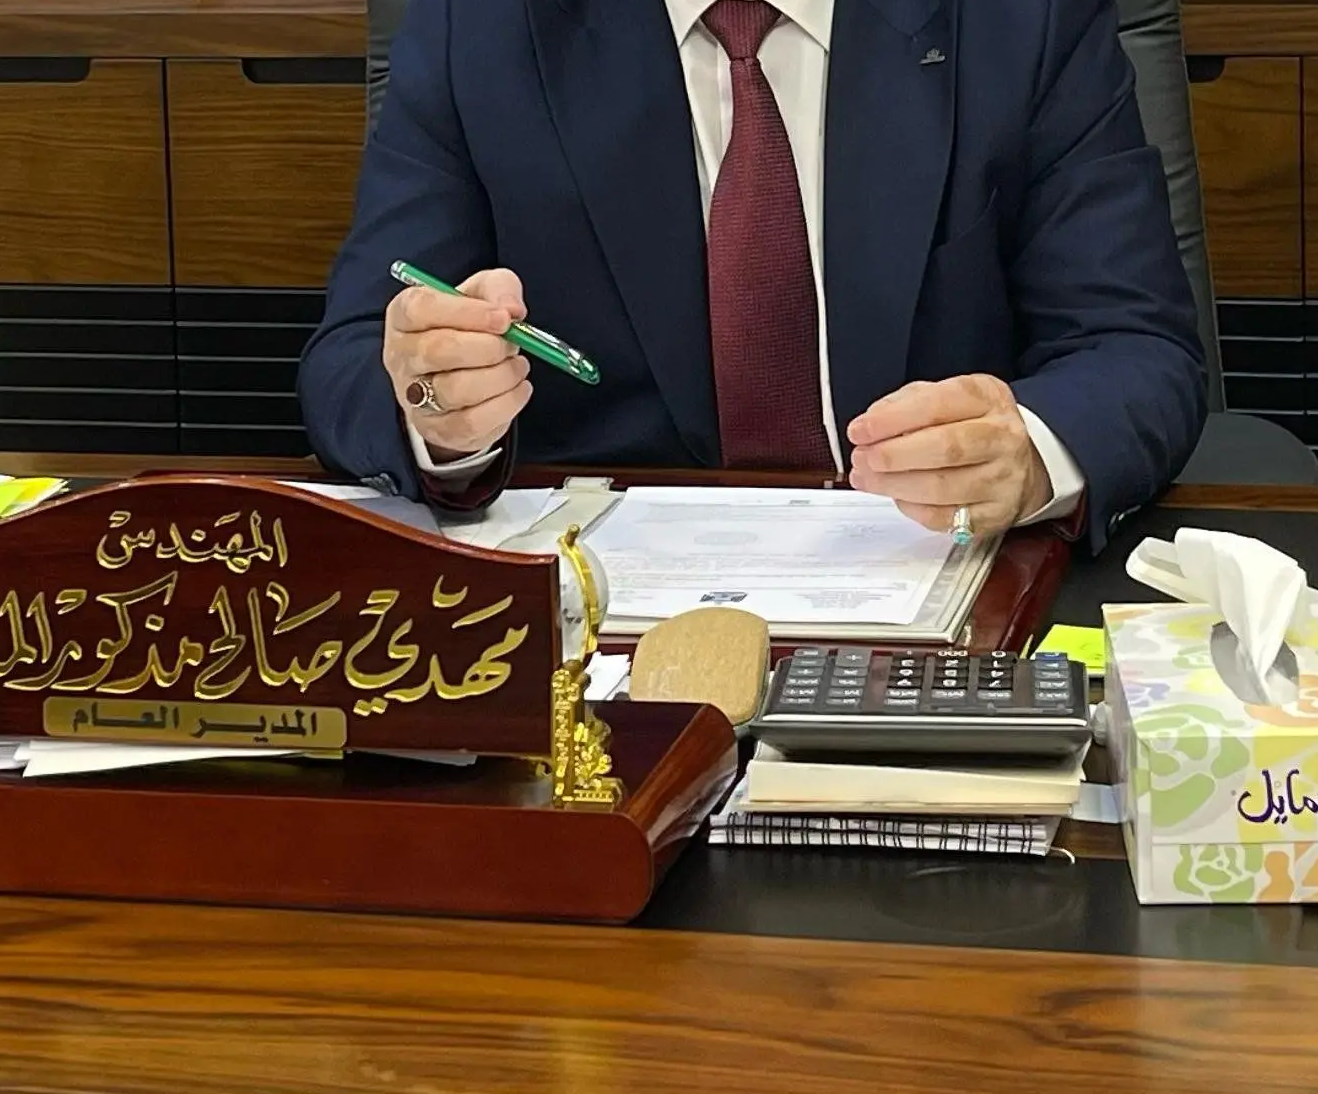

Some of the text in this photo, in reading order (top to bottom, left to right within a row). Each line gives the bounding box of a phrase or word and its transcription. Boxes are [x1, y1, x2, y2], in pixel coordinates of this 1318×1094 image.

[97, 509, 289, 573] المهندس
[3, 570, 204, 695] مذكور
[194, 581, 344, 701] صالح
[343, 574, 530, 717] مهدي
[72, 701, 319, 745] المدير العام
